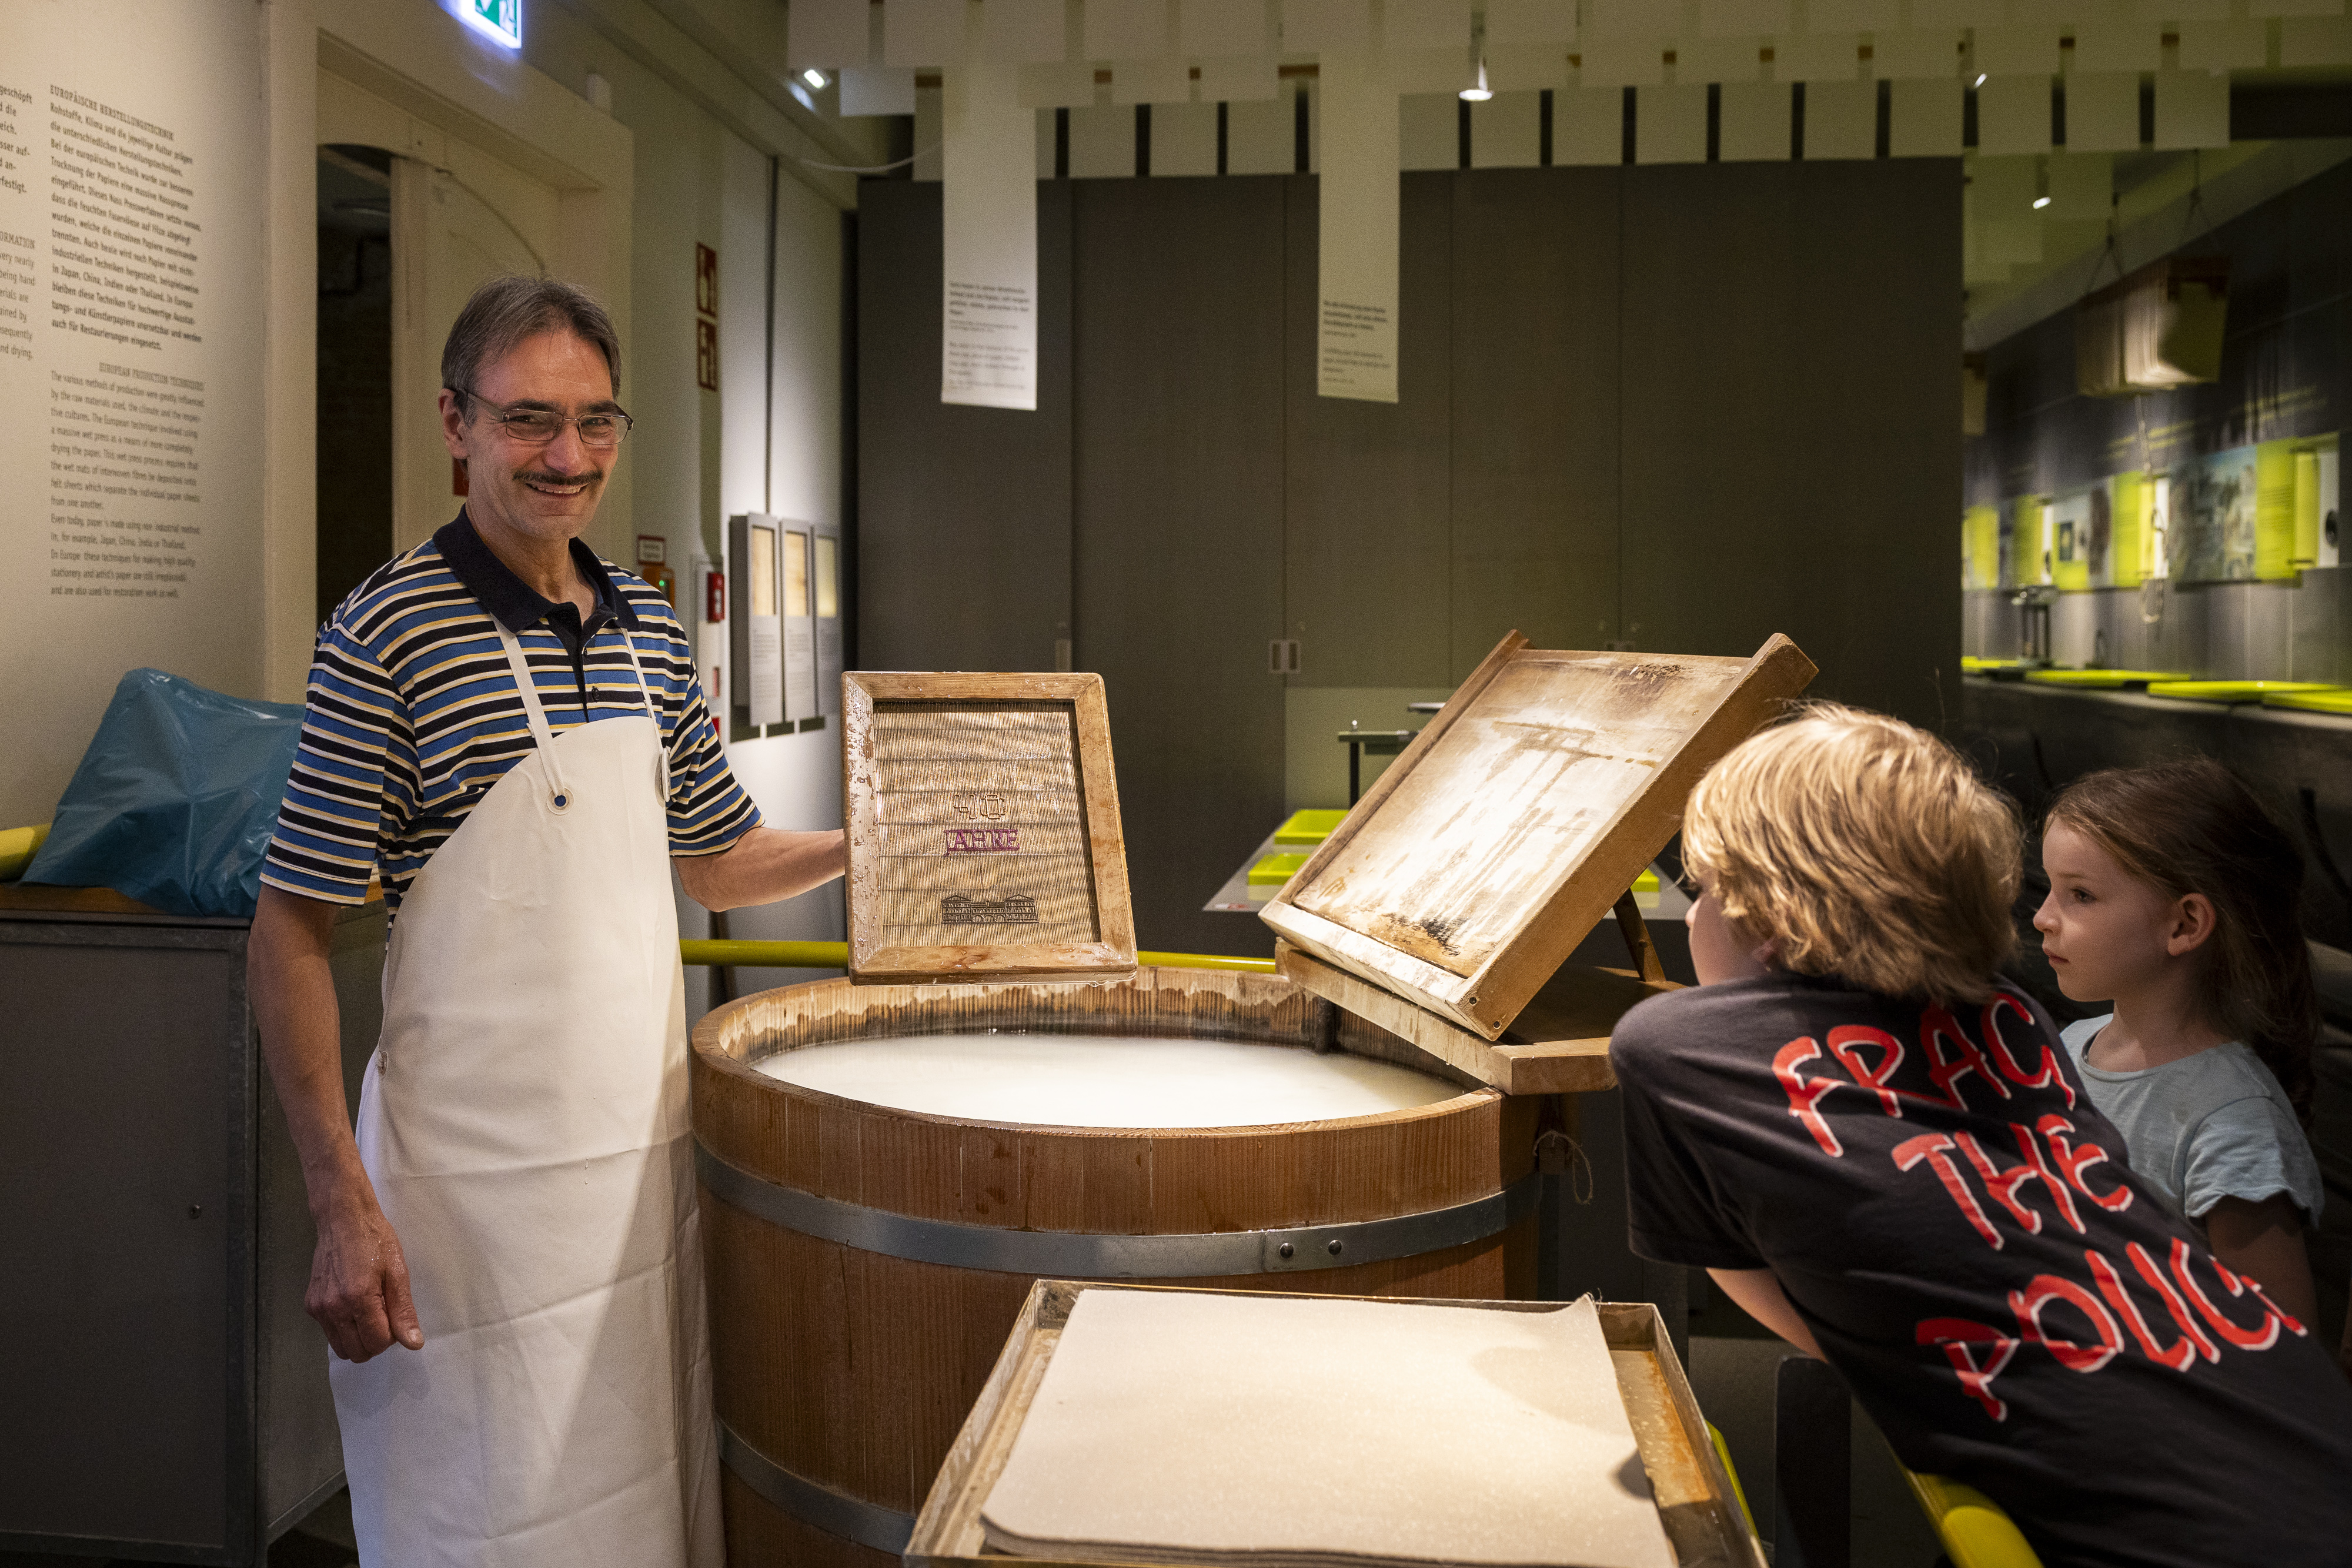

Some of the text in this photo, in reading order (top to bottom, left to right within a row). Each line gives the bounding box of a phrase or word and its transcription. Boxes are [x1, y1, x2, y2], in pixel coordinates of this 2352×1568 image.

[5, 103, 16, 116] die
[50, 84, 96, 111] EUROPÄISCHE
[86, 116, 102, 129] Klima
[50, 121, 60, 132] die
[63, 128, 116, 152] unterschiedlichen
[51, 138, 61, 149] Bei
[64, 144, 73, 153] der
[76, 150, 115, 168] europäischen
[51, 156, 83, 177] Trocknung
[86, 169, 95, 178] der
[98, 172, 118, 186] Papiere
[51, 192, 65, 204] dass
[68, 198, 77, 208] die
[80, 201, 106, 216] feuchten
[88, 186, 106, 200] Dieses
[79, 221, 99, 232] welche
[84, 238, 98, 248] Auch
[14, 256, 34, 270] nearly
[52, 245, 92, 264] industriellen
[95, 257, 123, 272] Techniken
[52, 263, 58, 273] in
[19, 273, 35, 286] hand
[52, 281, 75, 295] bleiben
[78, 289, 94, 300] diese
[96, 292, 125, 307] Techniken
[19, 309, 26, 323] by
[88, 309, 135, 326] Künstlerpapiere
[51, 319, 66, 328] auch
[69, 321, 78, 330] für
[81, 323, 128, 343] Restaurierungen
[953, 794, 1007, 819] 40
[943, 829, 1020, 857] JAHRE
[1892, 1113, 2134, 1251] THE
